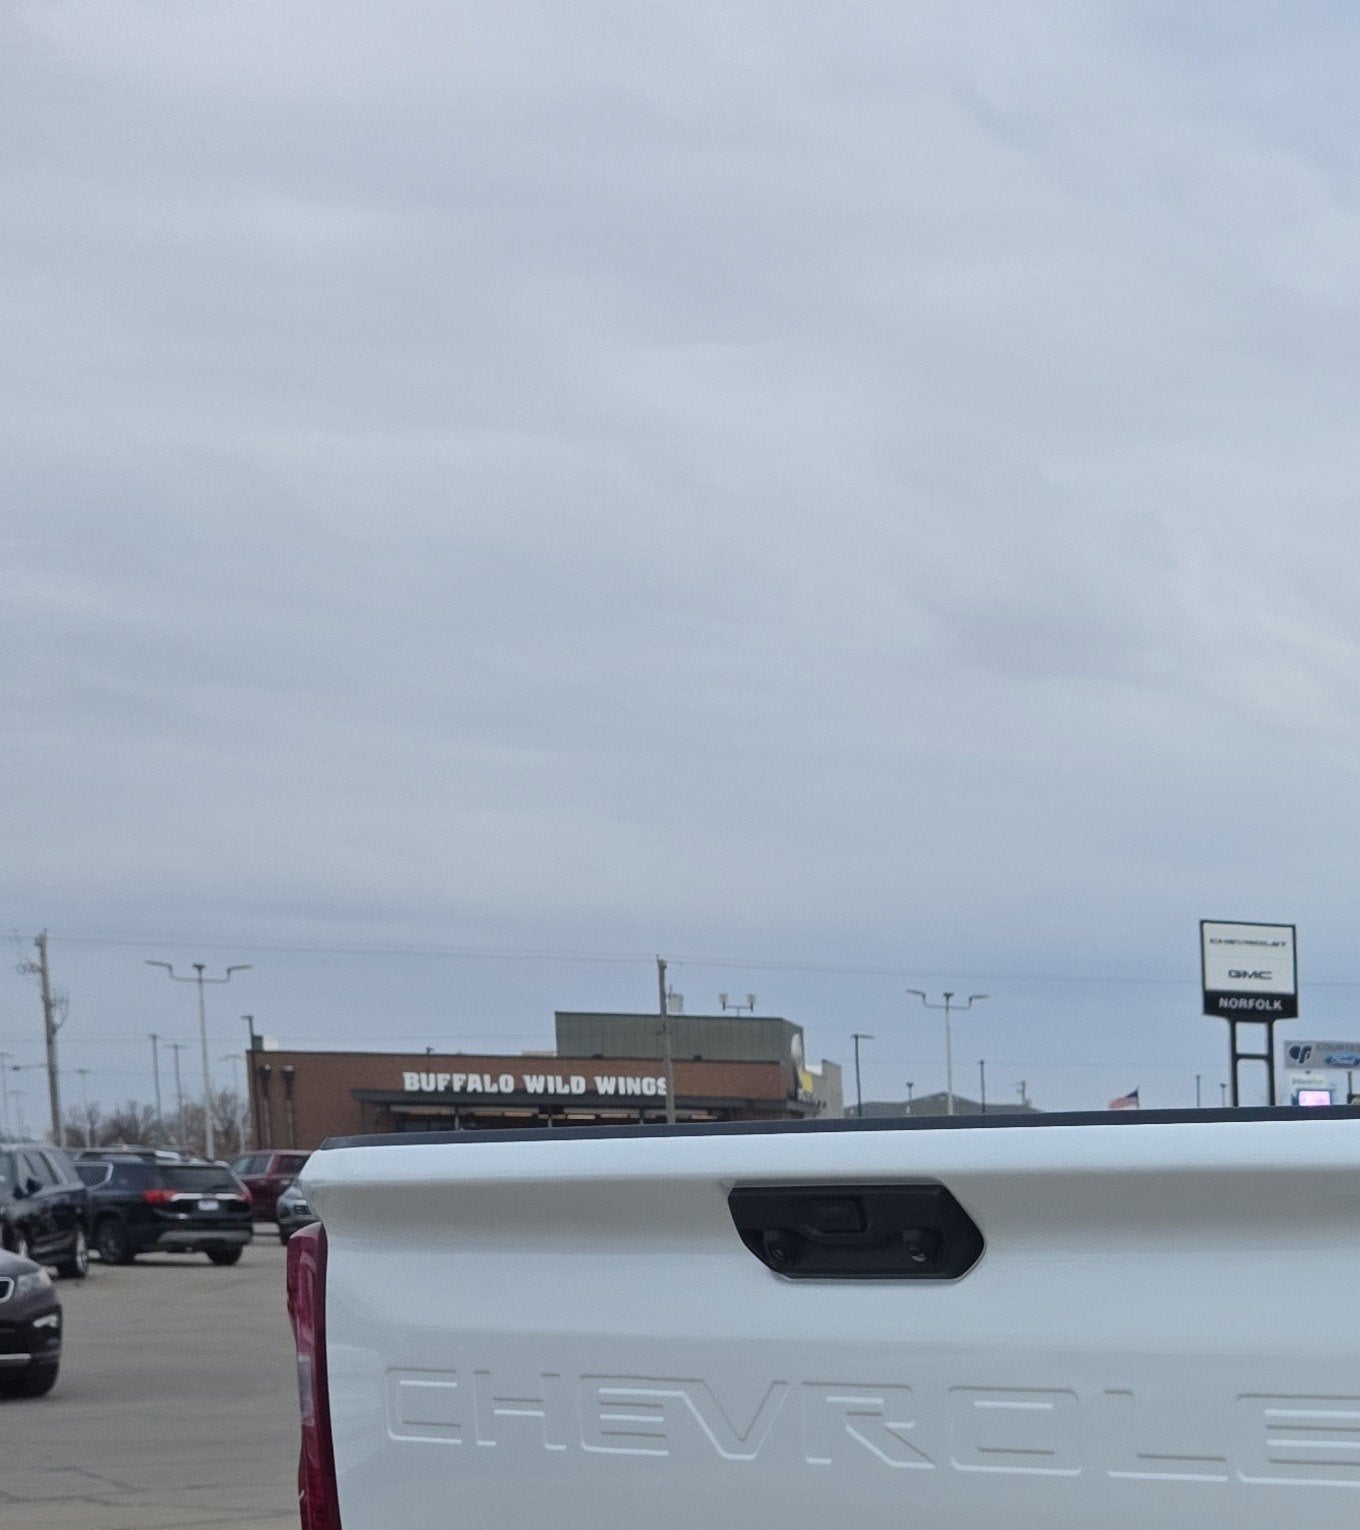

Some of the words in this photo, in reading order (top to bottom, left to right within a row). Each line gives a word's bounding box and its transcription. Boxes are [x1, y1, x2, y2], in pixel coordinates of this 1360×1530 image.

[1228, 969, 1272, 980] GMC
[1218, 997, 1283, 1011] NORFOLK
[402, 1071, 515, 1094] BUFFALO
[523, 1074, 586, 1095] WILD
[593, 1075, 668, 1096] WINGS
